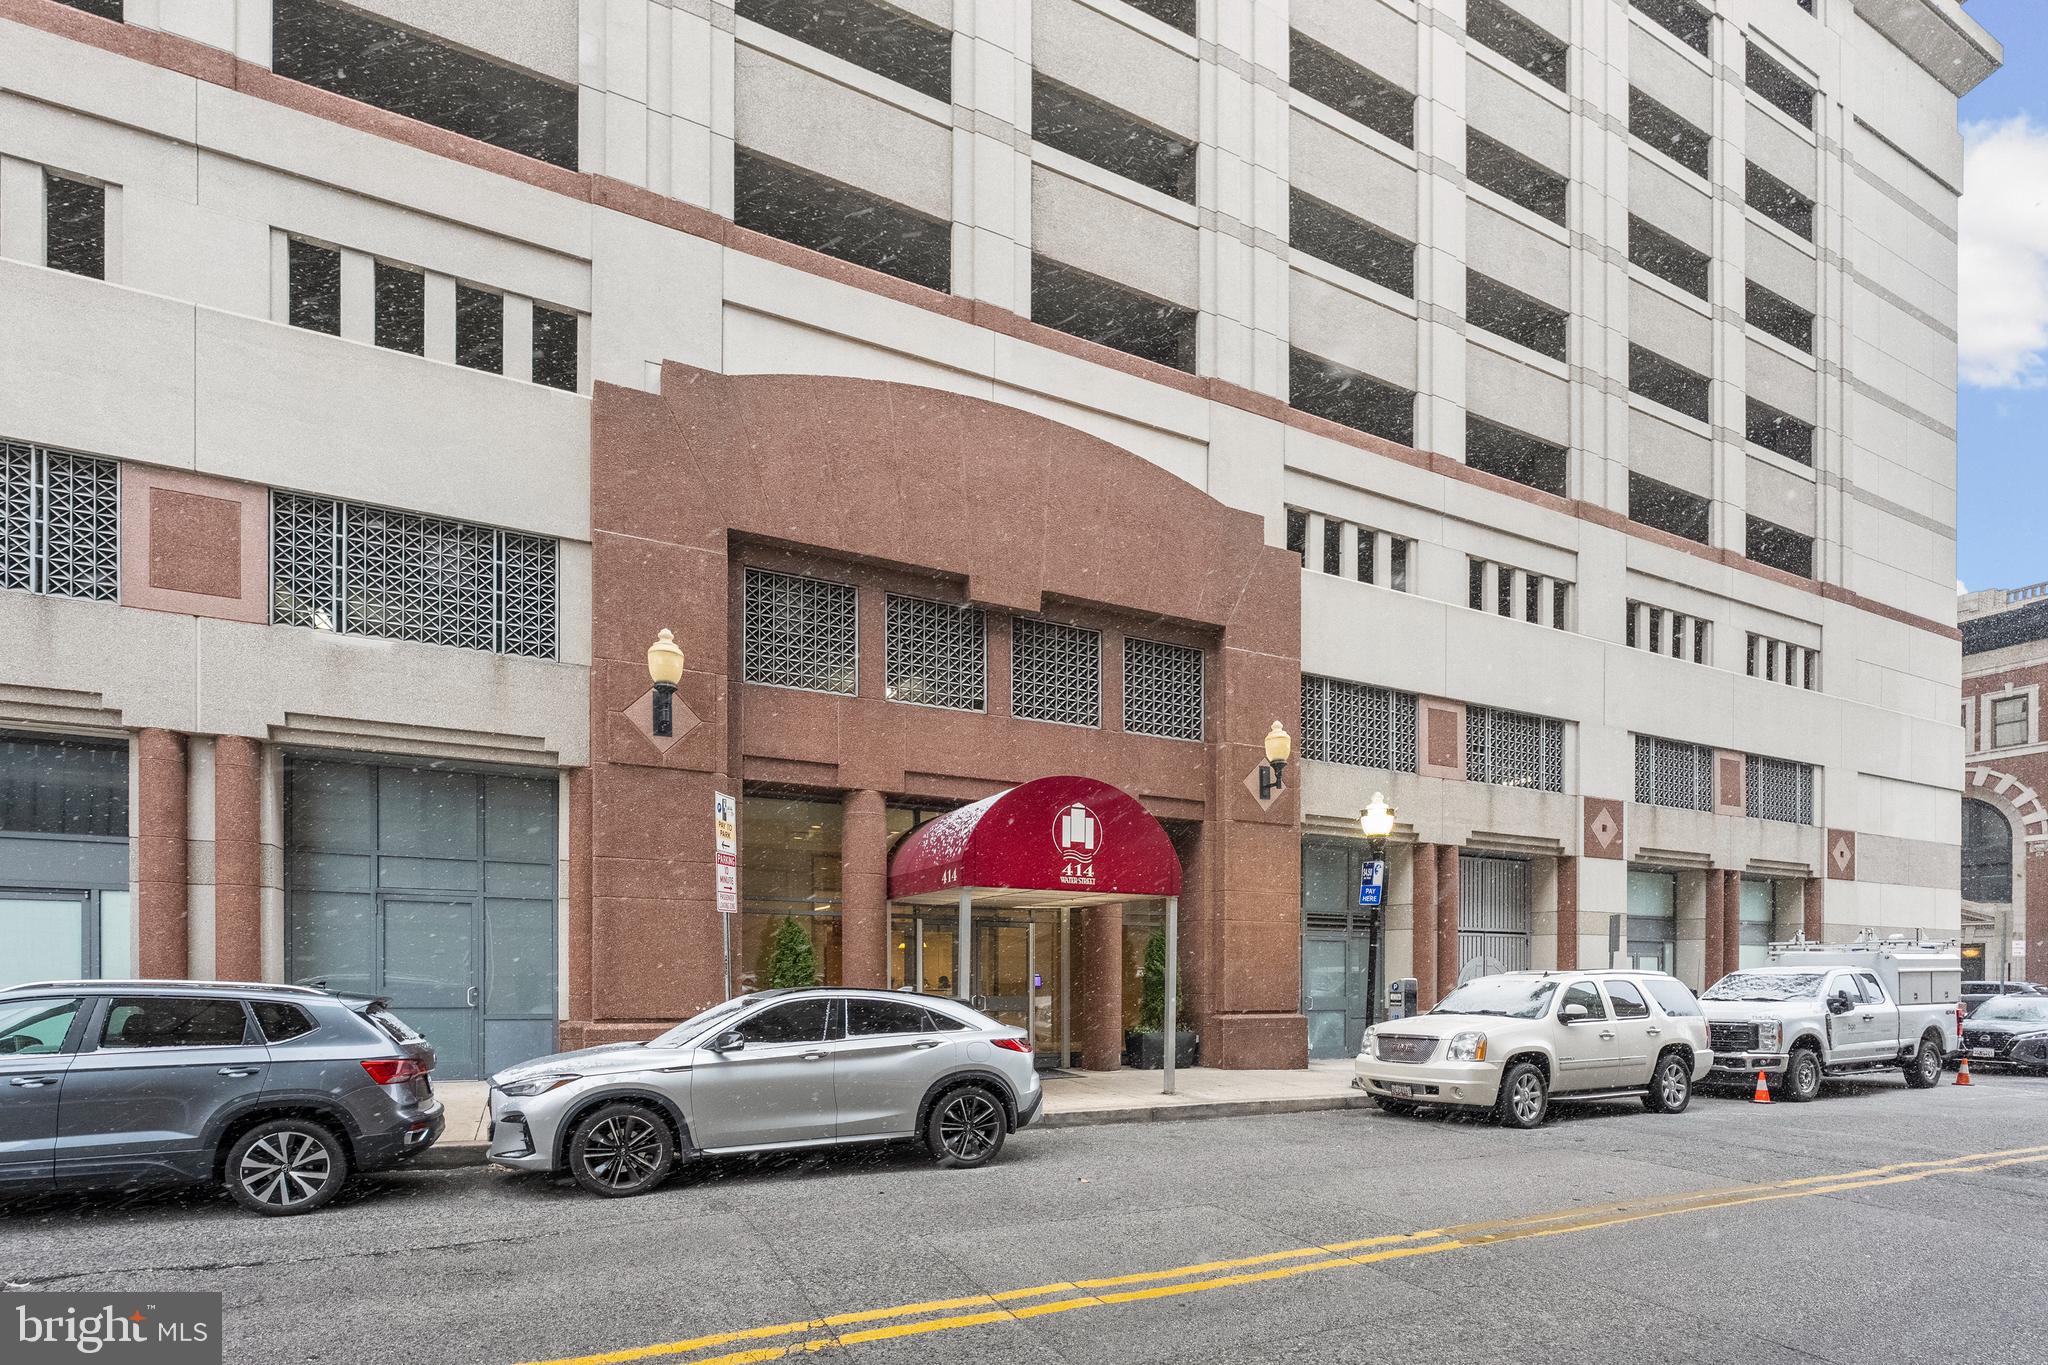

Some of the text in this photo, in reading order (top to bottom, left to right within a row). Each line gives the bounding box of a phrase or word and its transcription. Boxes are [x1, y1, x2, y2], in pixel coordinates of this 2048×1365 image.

[720, 829, 732, 840] PARK
[717, 853, 735, 867] PARKING
[1061, 862, 1095, 878] 414
[719, 875, 734, 885] MINUTE
[941, 867, 958, 885] 414
[1060, 876, 1096, 885] WATER STREET
[1365, 887, 1376, 895] PAY
